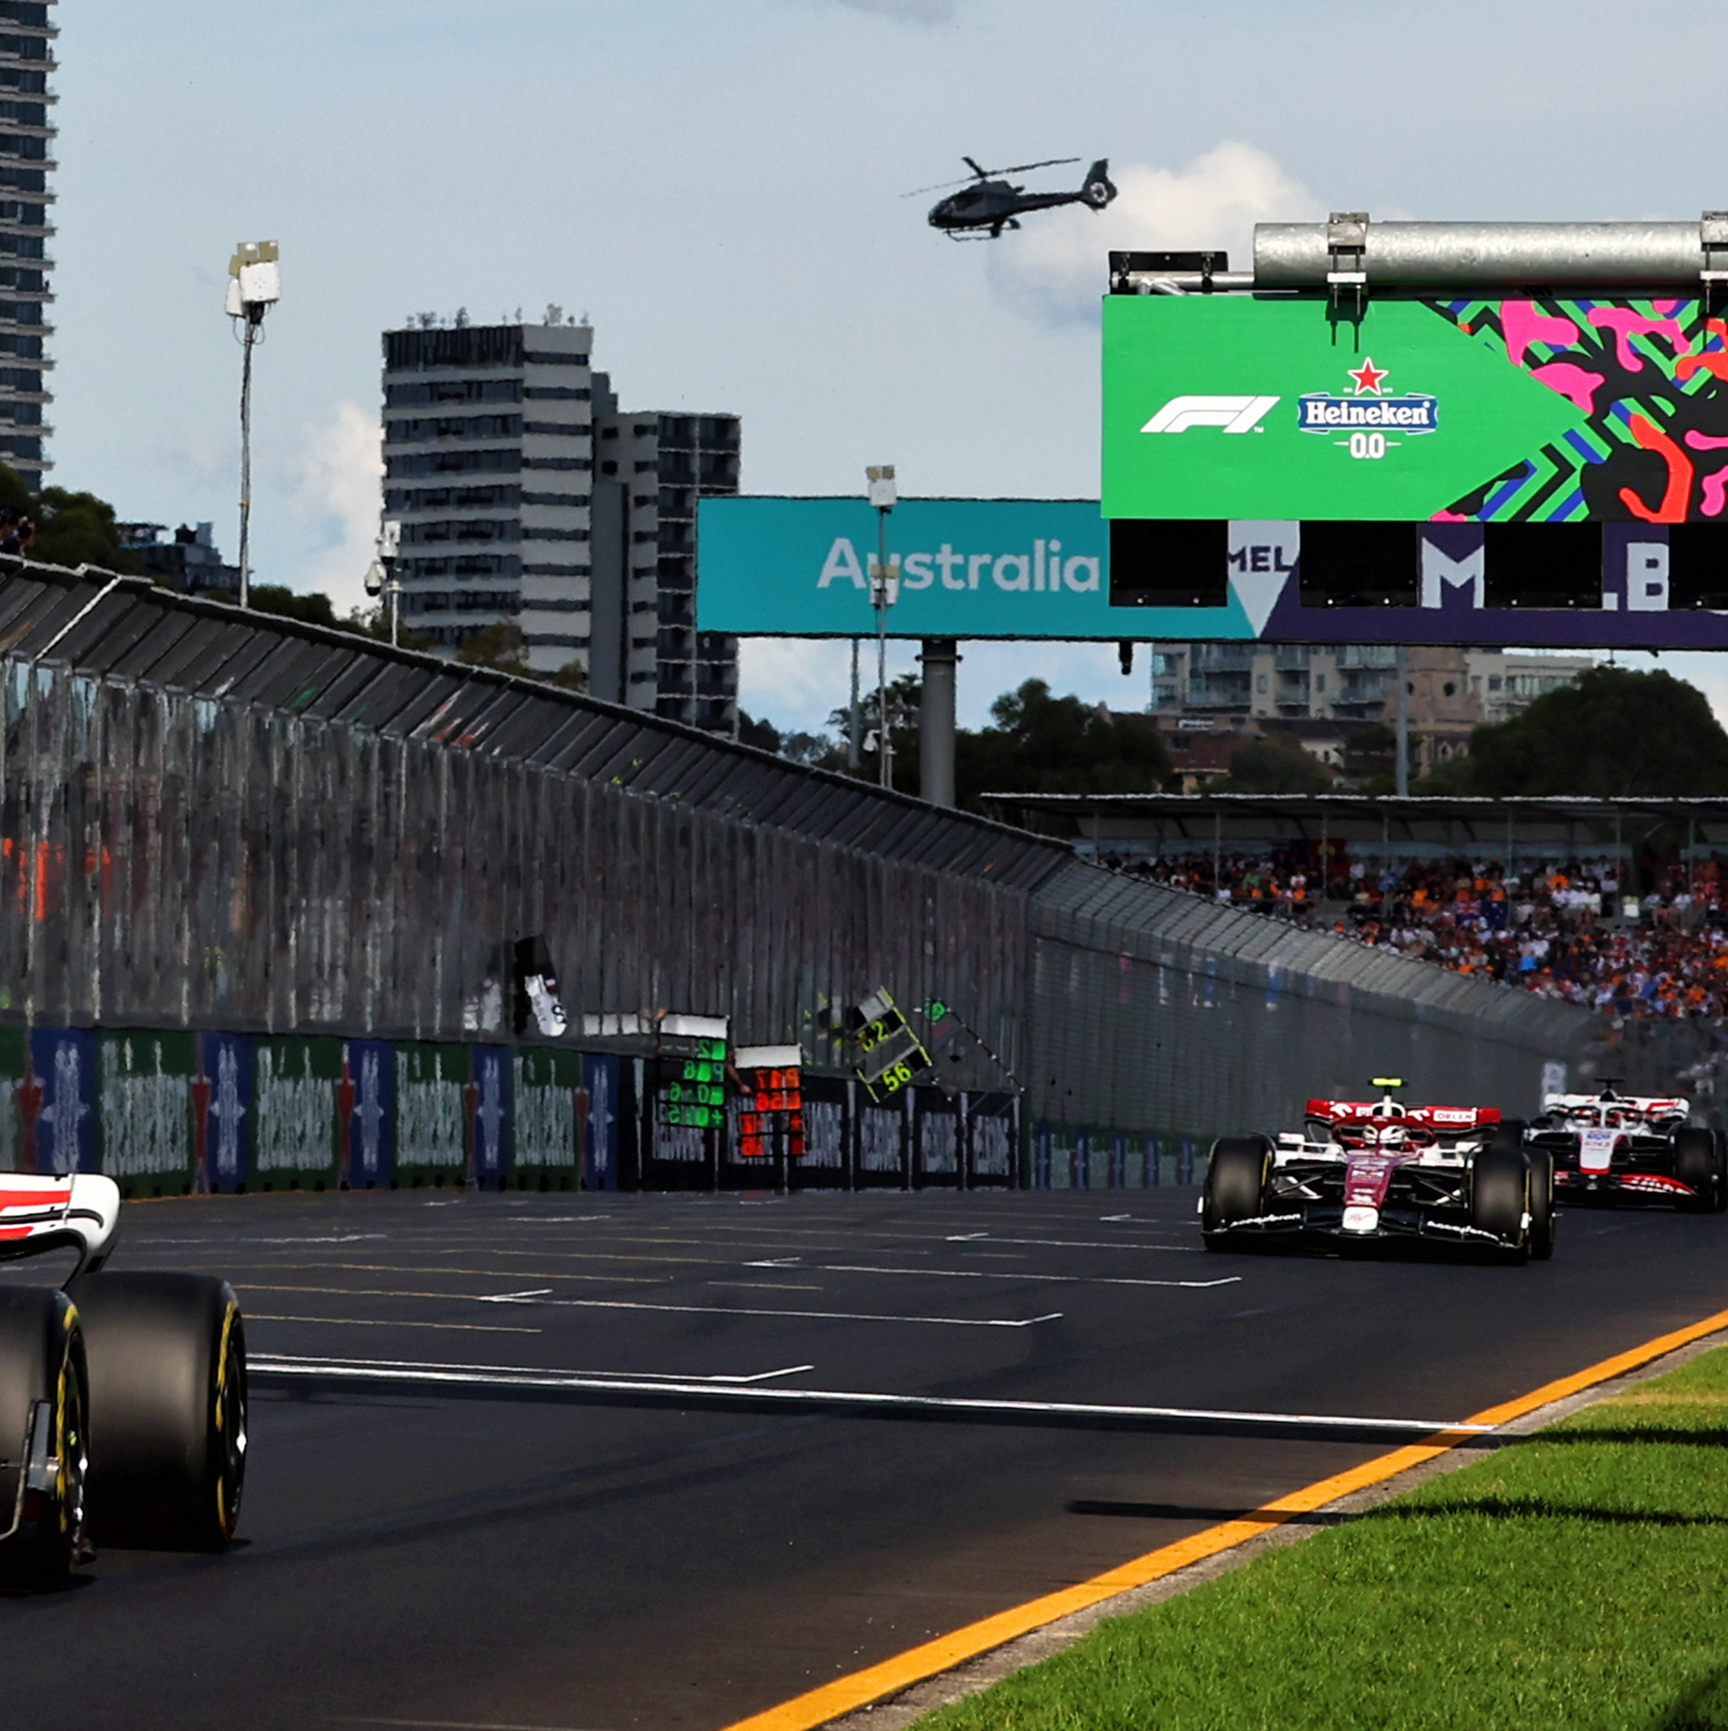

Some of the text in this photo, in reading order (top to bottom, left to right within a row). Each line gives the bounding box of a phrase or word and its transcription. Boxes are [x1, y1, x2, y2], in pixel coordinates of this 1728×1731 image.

[1349, 432, 1386, 459] 0.0
[882, 1062, 912, 1092] 56
[1436, 1112, 1474, 1121] ORLEN
